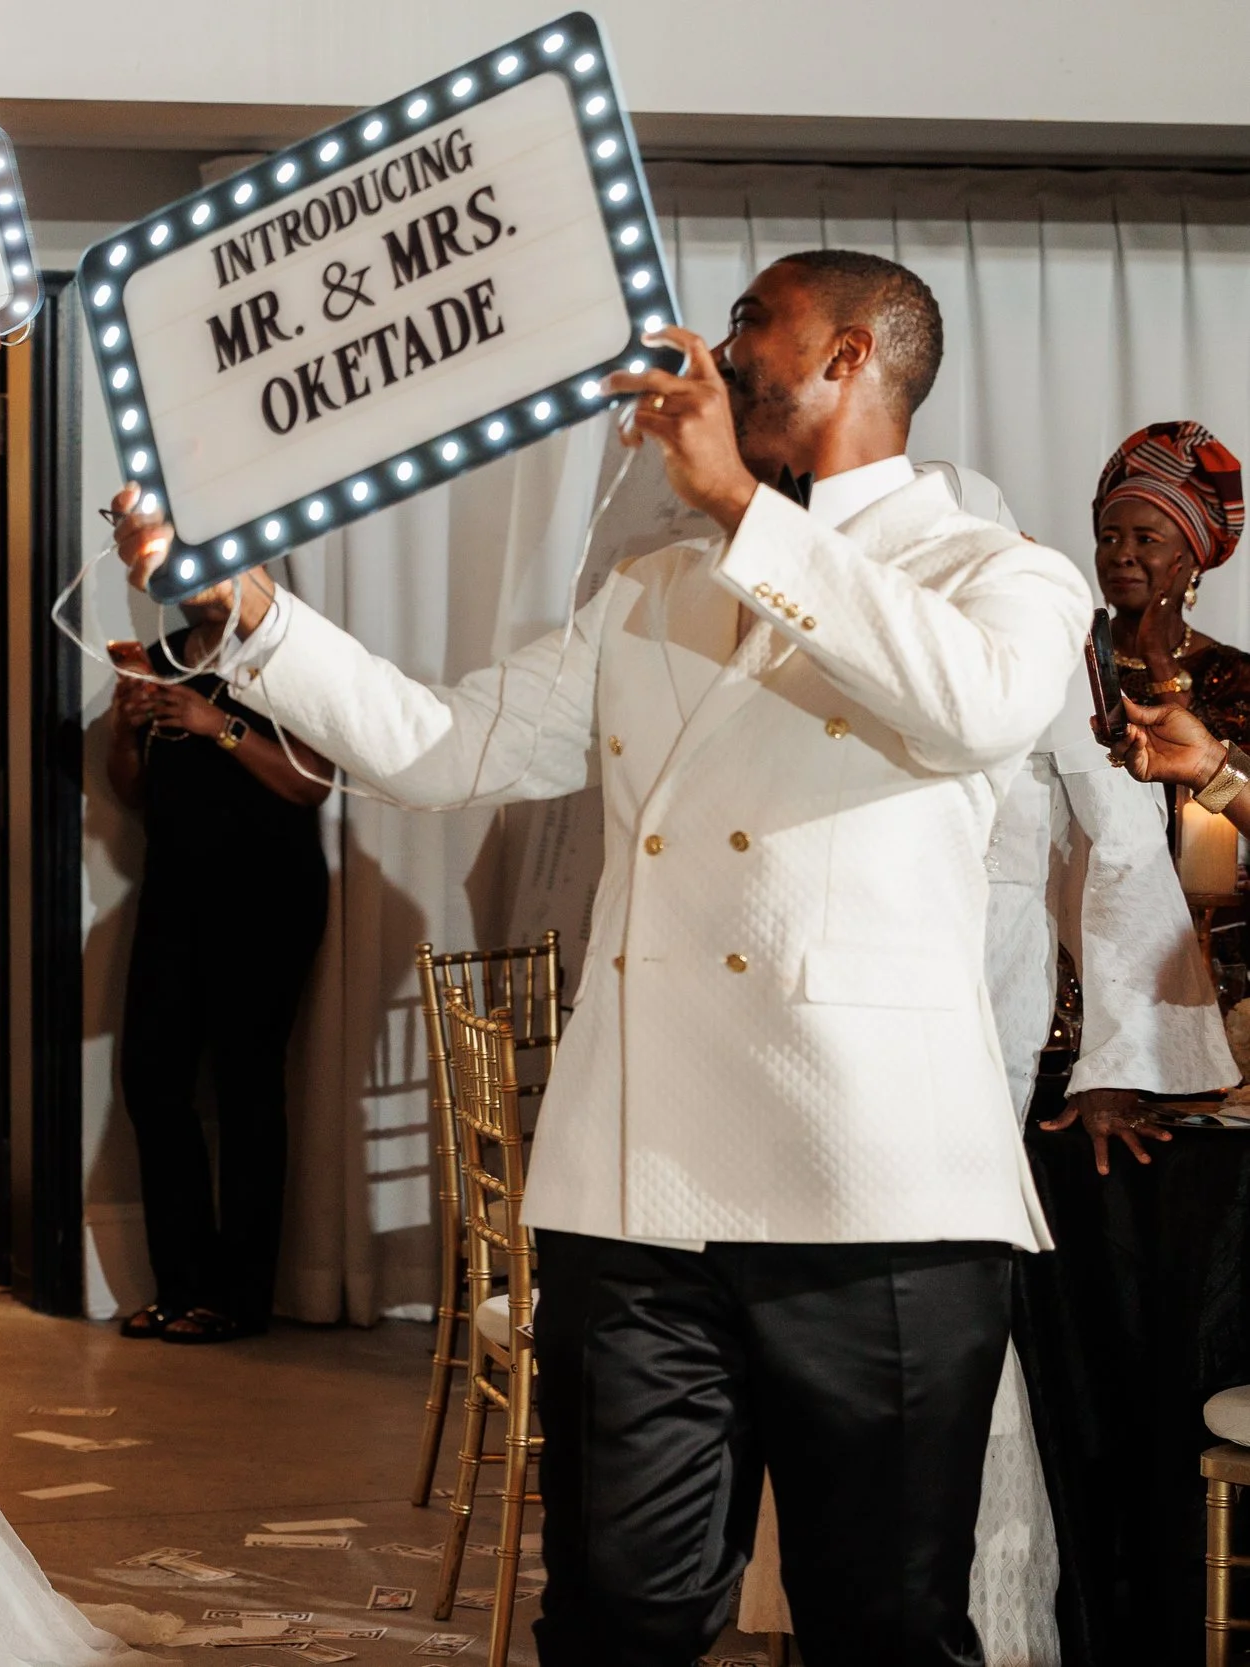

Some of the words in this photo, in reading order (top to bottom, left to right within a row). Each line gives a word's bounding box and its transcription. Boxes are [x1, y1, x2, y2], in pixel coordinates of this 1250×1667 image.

[206, 290, 305, 373] MR.
[321, 260, 376, 322] &
[381, 185, 517, 290] MRS.
[210, 128, 473, 289] INTRODUCING
[261, 277, 505, 436] OKETADE
